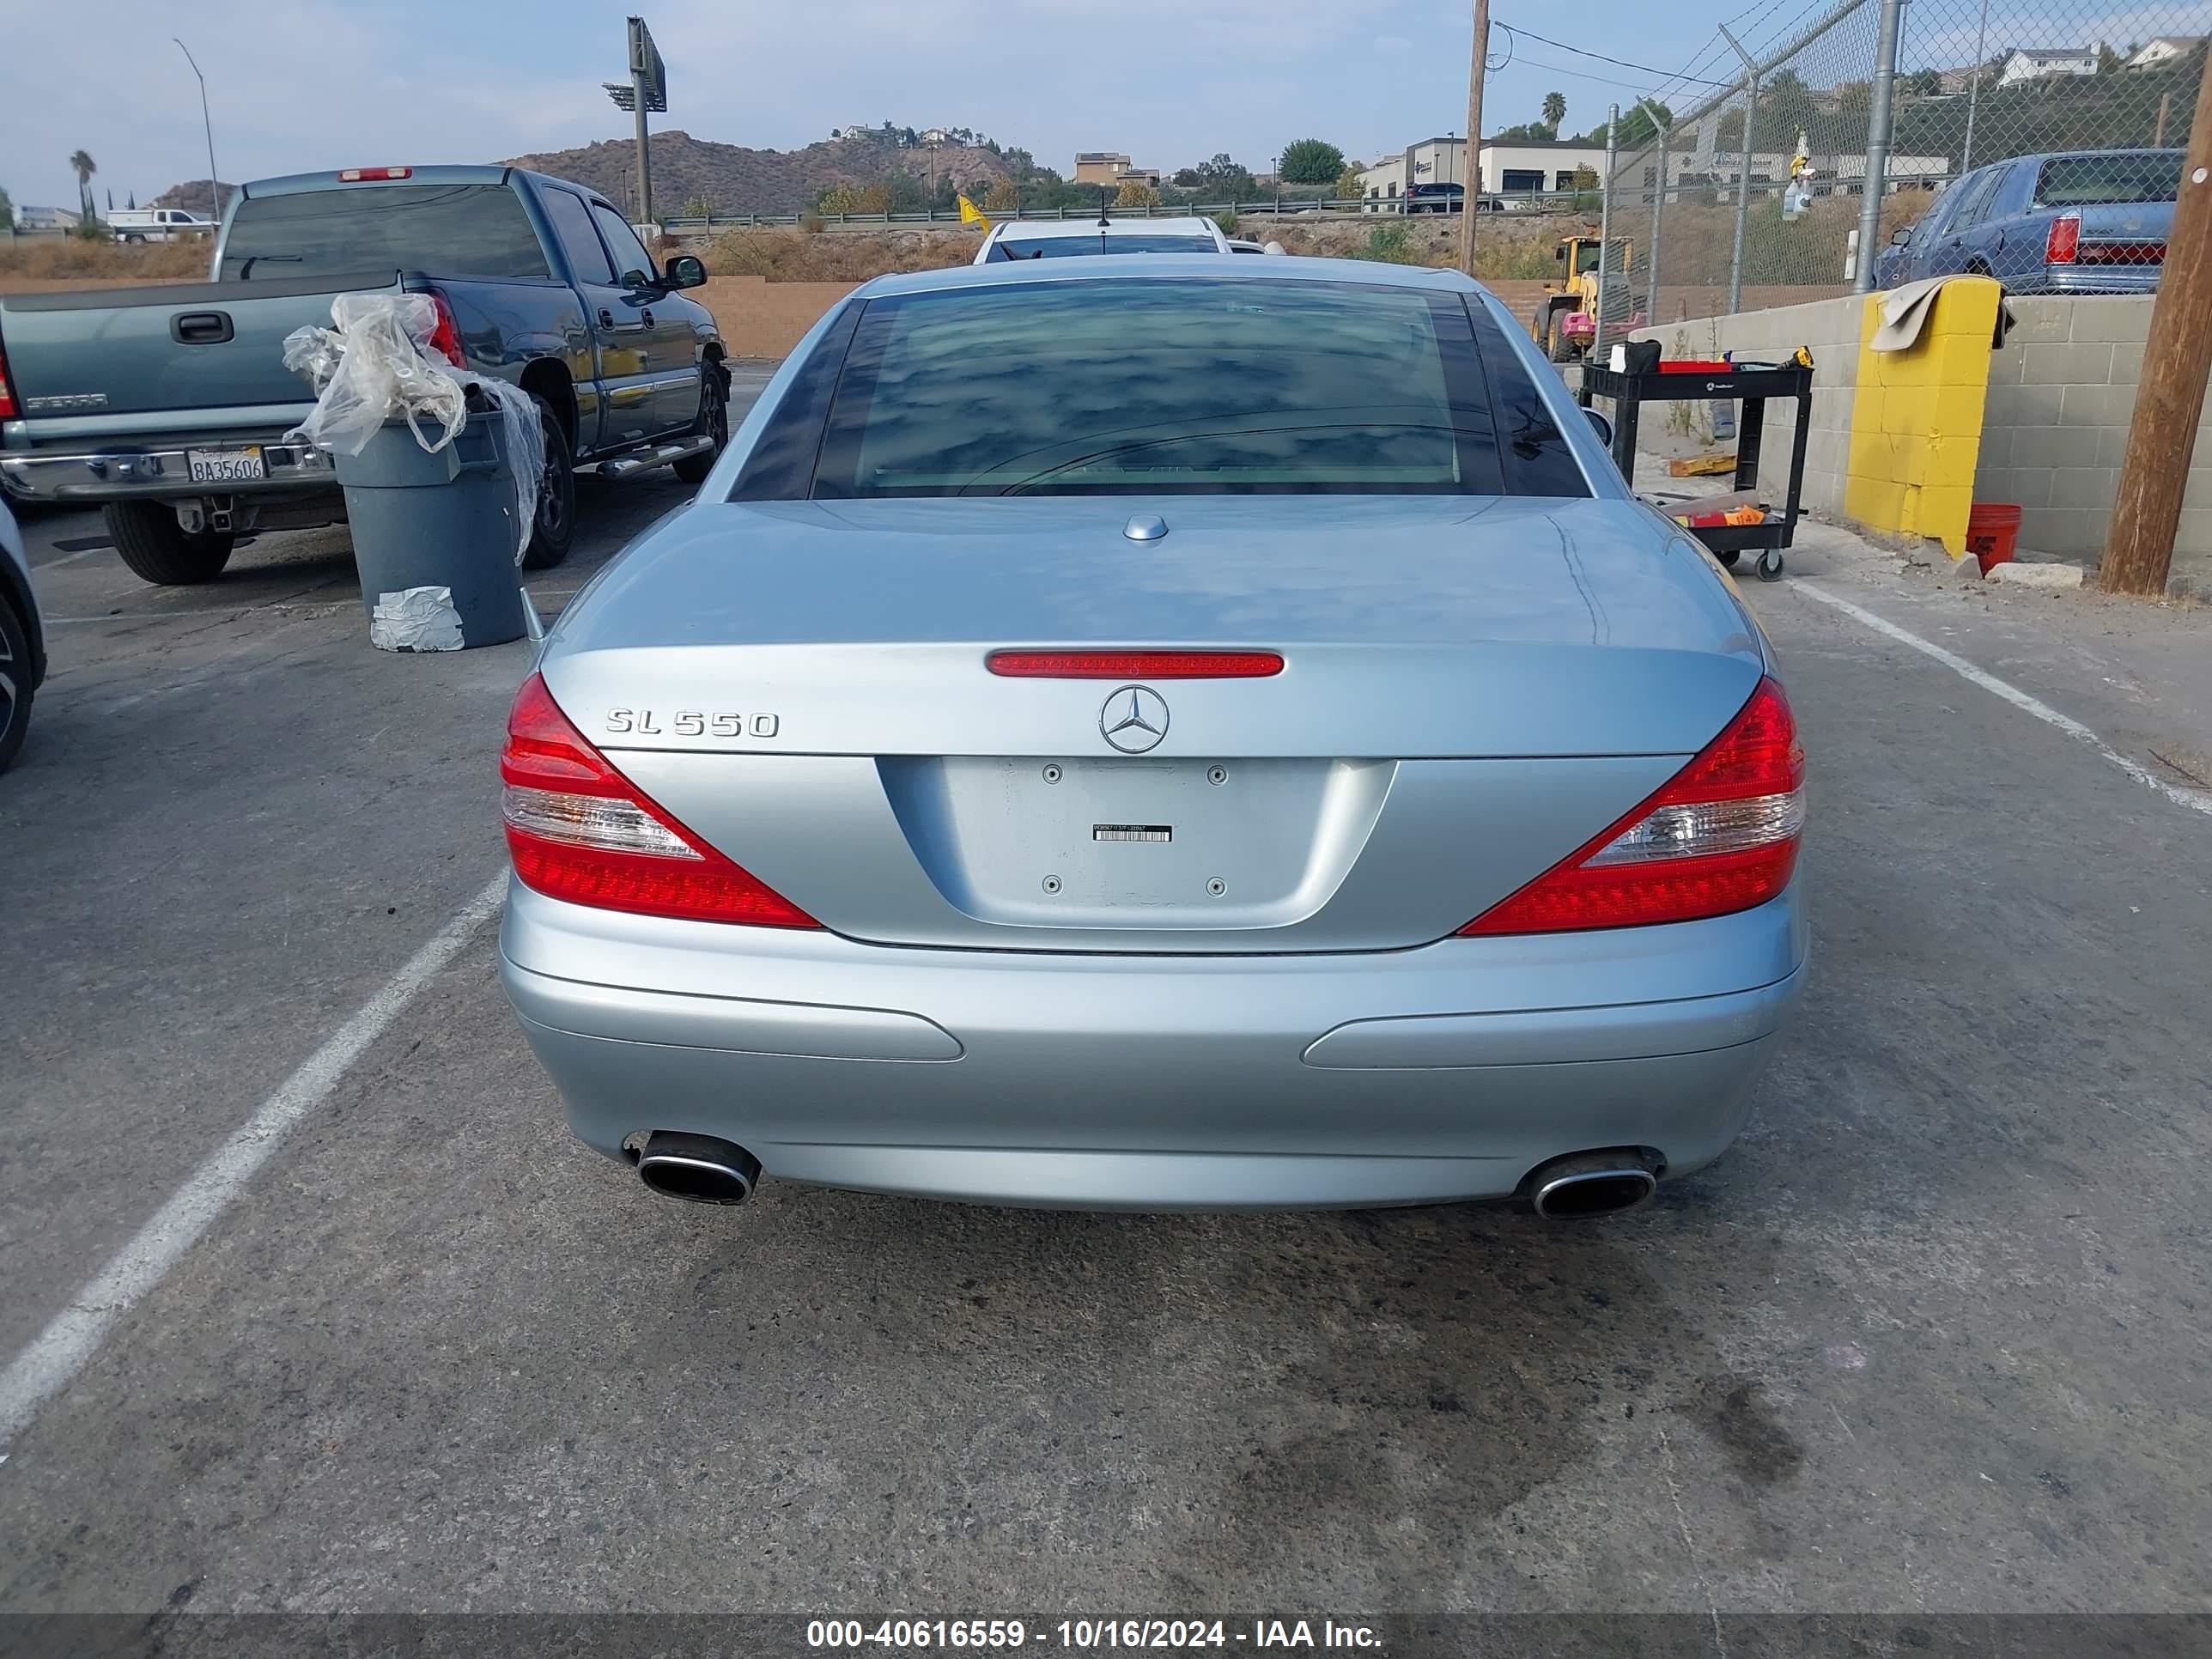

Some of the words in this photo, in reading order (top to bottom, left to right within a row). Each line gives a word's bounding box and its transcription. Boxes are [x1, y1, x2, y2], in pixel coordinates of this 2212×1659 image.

[27, 393, 109, 410] SIERRA
[193, 458, 262, 481] 8A35606
[605, 708, 661, 735] SL
[675, 711, 780, 738] 550
